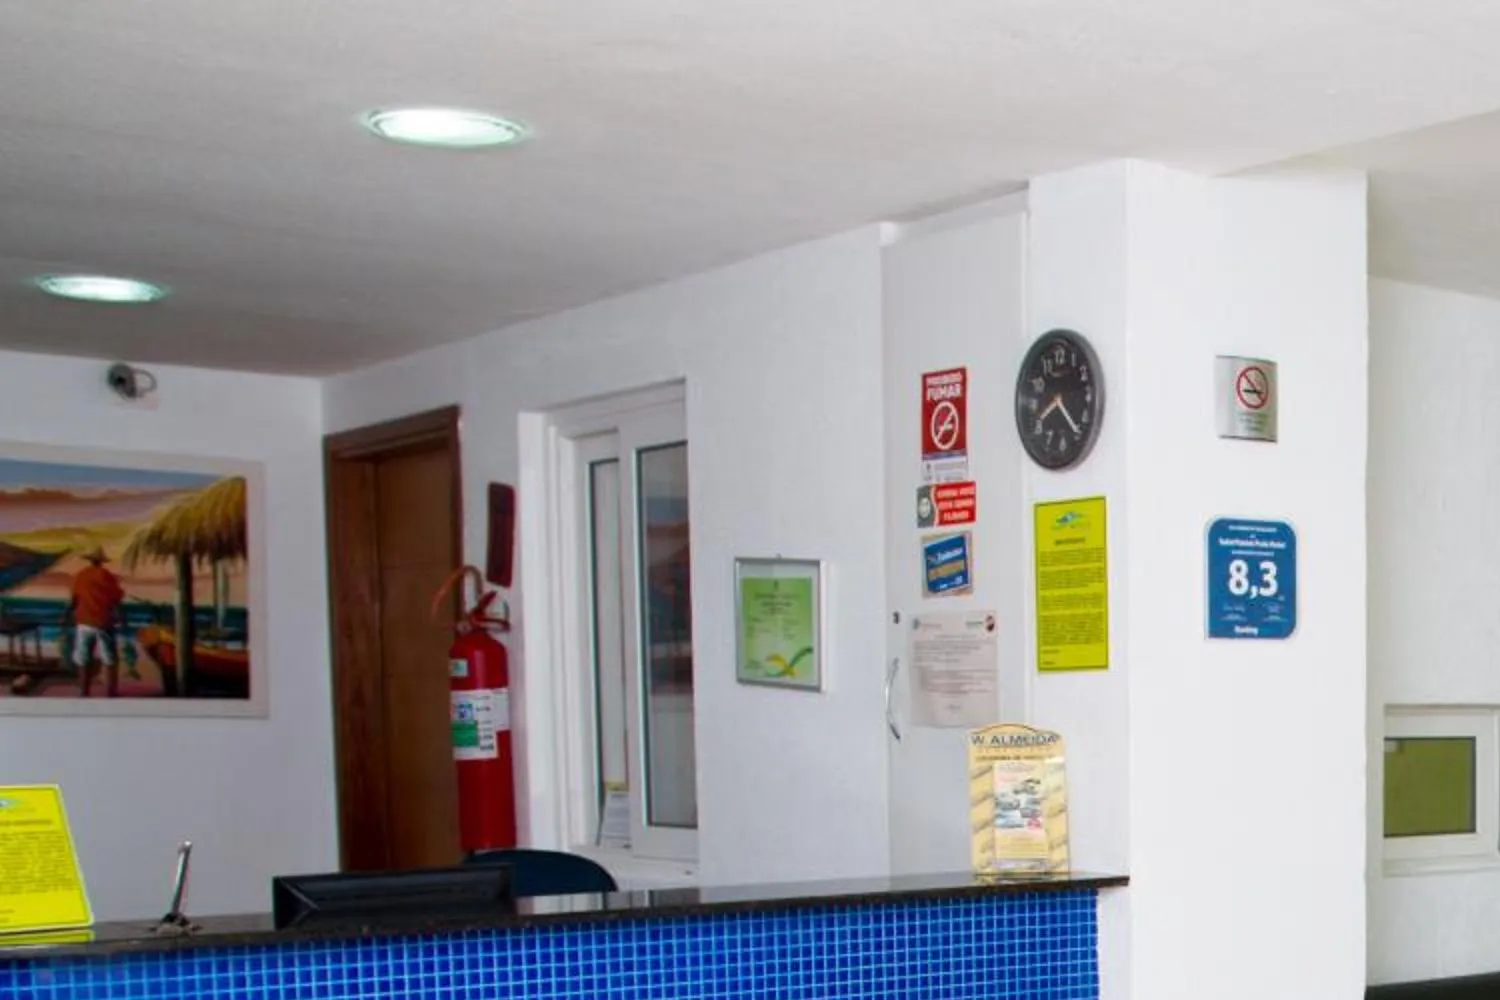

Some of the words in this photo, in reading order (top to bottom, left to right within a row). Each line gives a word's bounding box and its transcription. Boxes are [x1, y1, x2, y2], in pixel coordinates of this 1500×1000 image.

[1054, 347, 1065, 365] 12
[1070, 353, 1077, 367] 1
[1042, 356, 1053, 376] 11
[1079, 364, 1088, 382] 2
[1030, 377, 1045, 393] 10
[1228, 559, 1278, 599] 8,3
